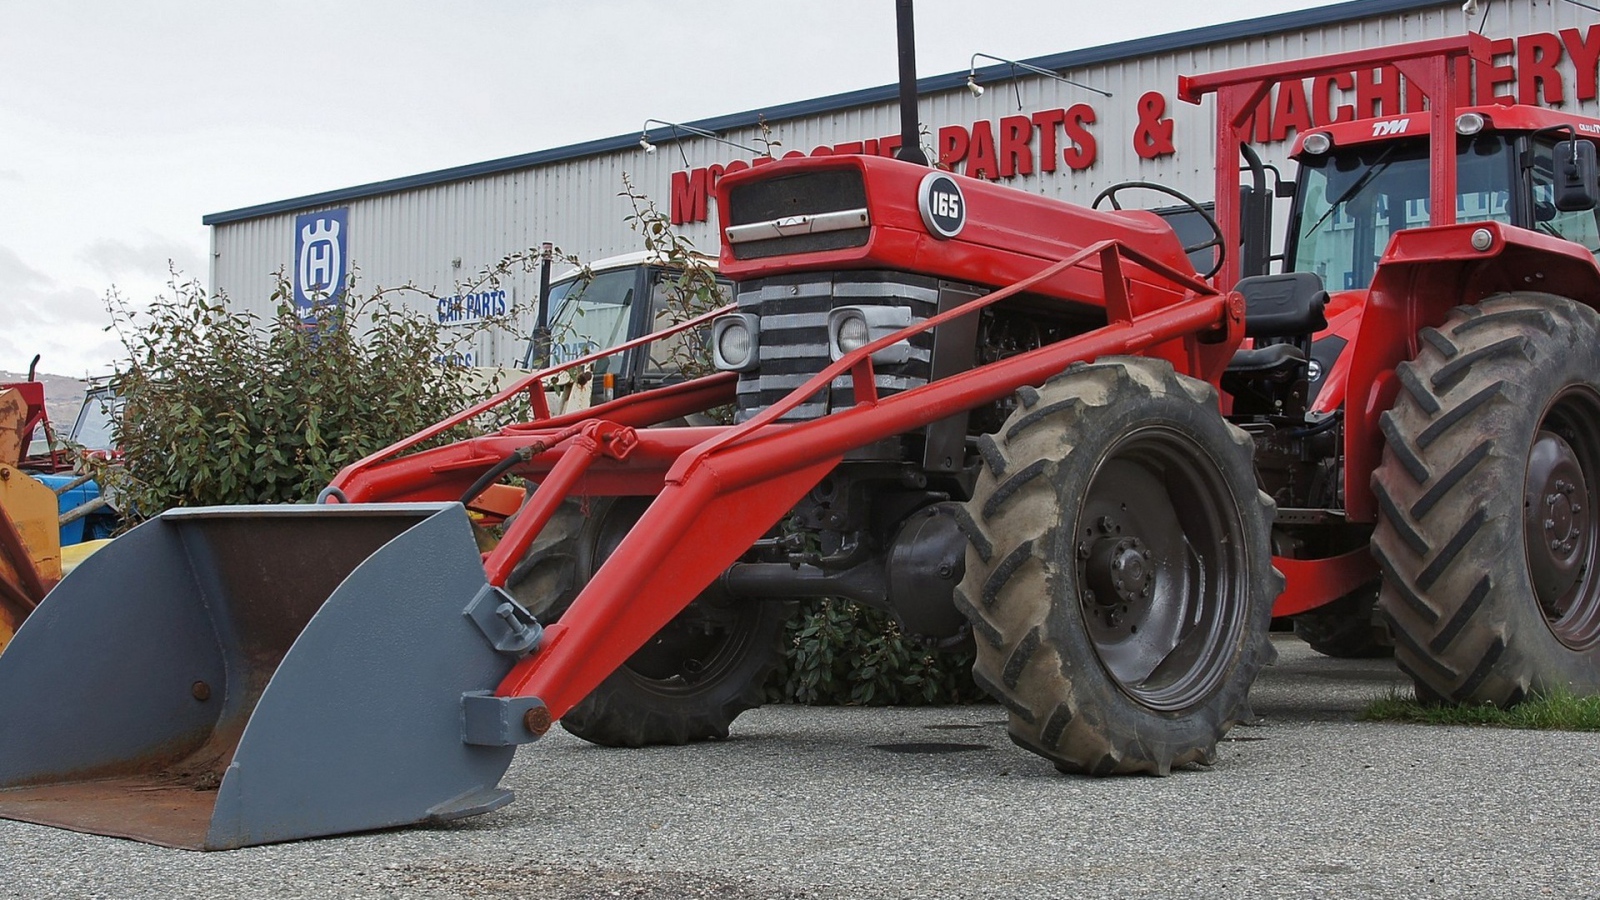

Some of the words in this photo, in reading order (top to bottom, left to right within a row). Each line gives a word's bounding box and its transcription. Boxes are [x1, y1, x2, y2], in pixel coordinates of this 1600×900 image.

[938, 103, 1097, 180] PARTS
[1133, 91, 1176, 158] &
[1372, 118, 1411, 137] TYM
[932, 190, 959, 218] 165
[466, 290, 506, 320] PARTS
